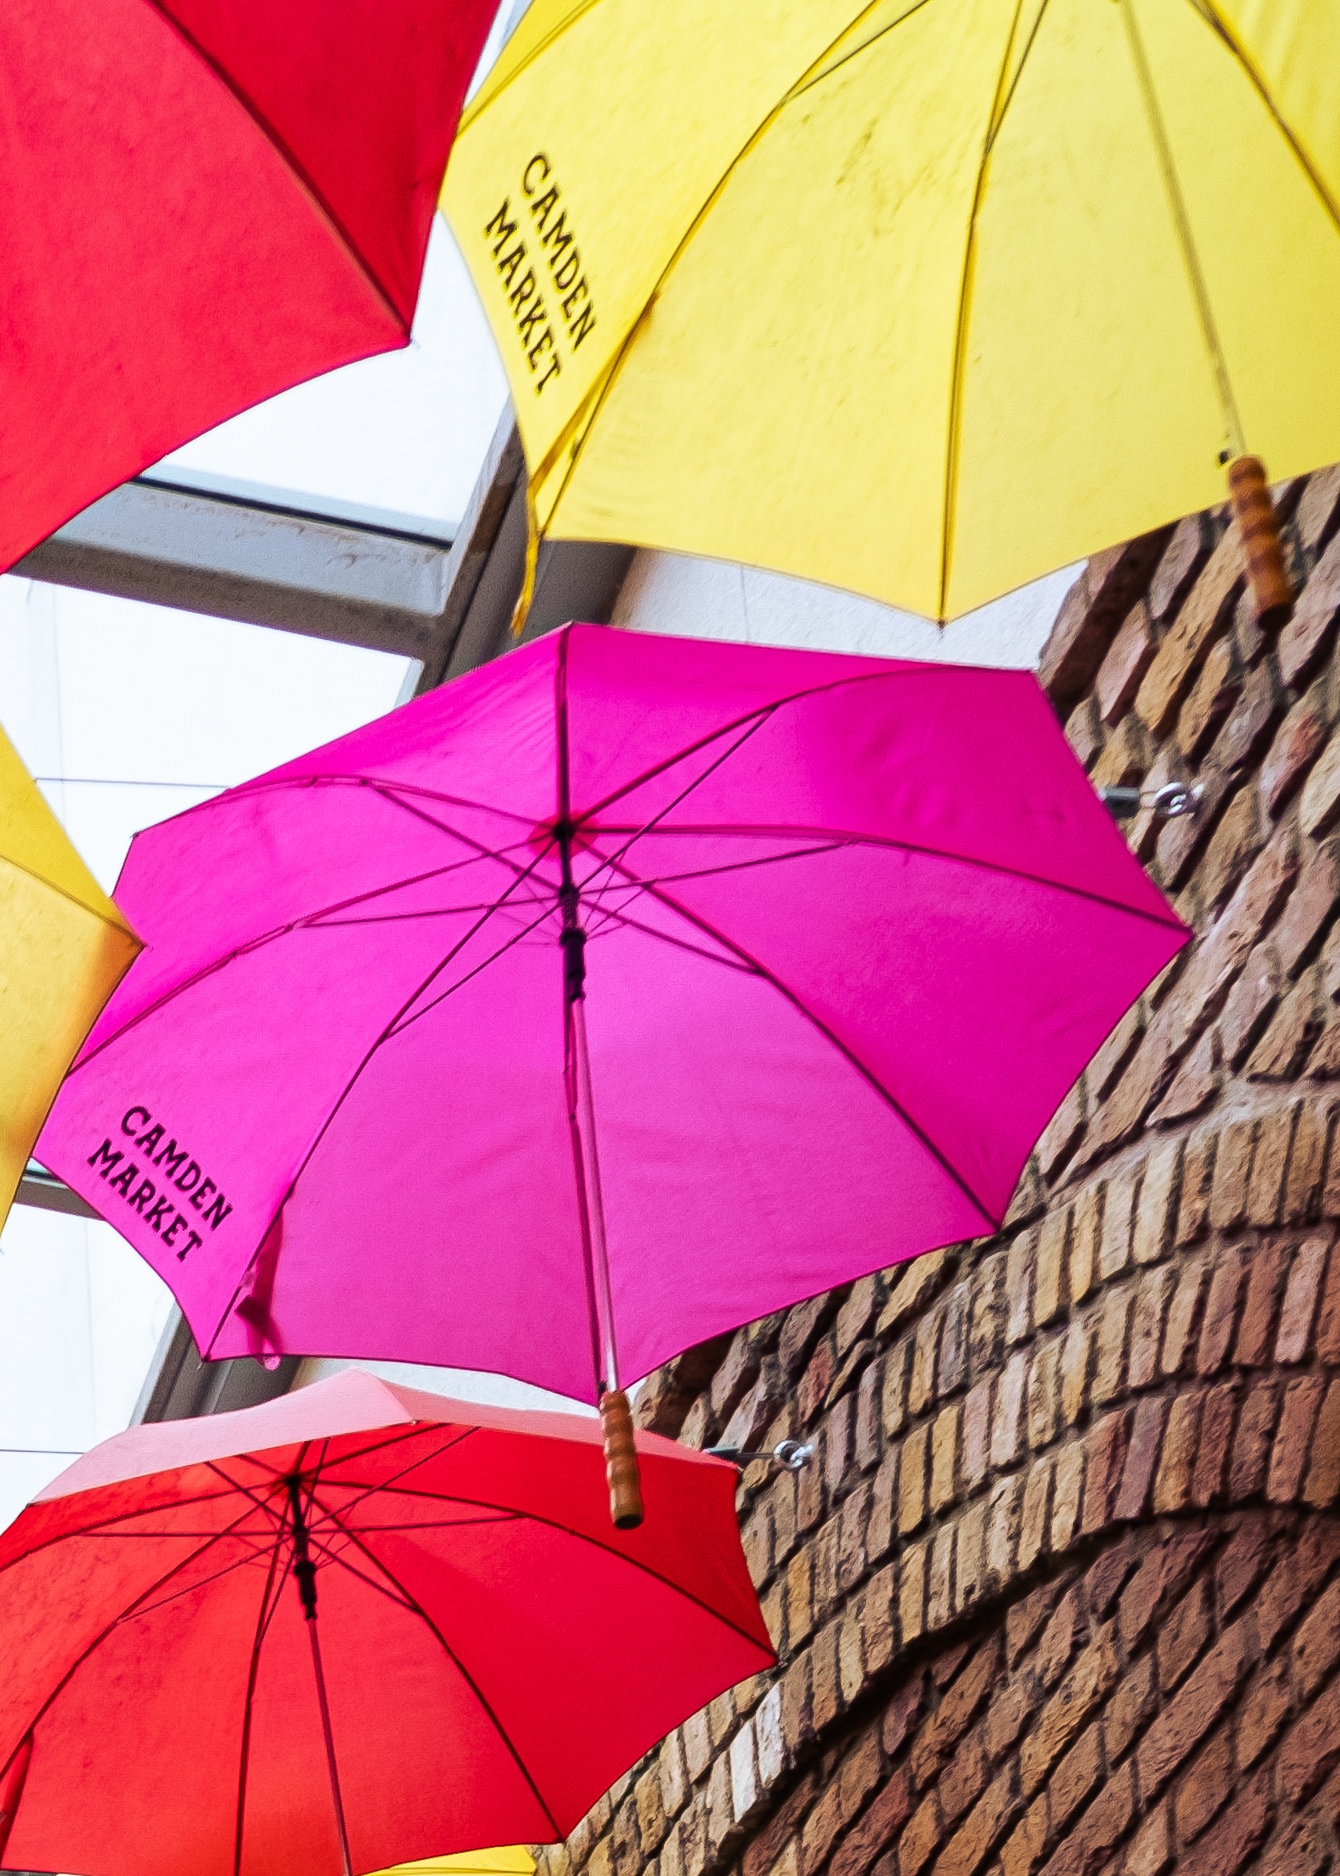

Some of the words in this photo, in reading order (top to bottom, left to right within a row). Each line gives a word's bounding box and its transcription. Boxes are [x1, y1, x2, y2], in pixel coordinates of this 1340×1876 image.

[485, 198, 561, 394] MARKET
[523, 153, 596, 351] CAMDEN
[87, 1139, 202, 1262] MARKET
[121, 1106, 233, 1231] CAMDEN
